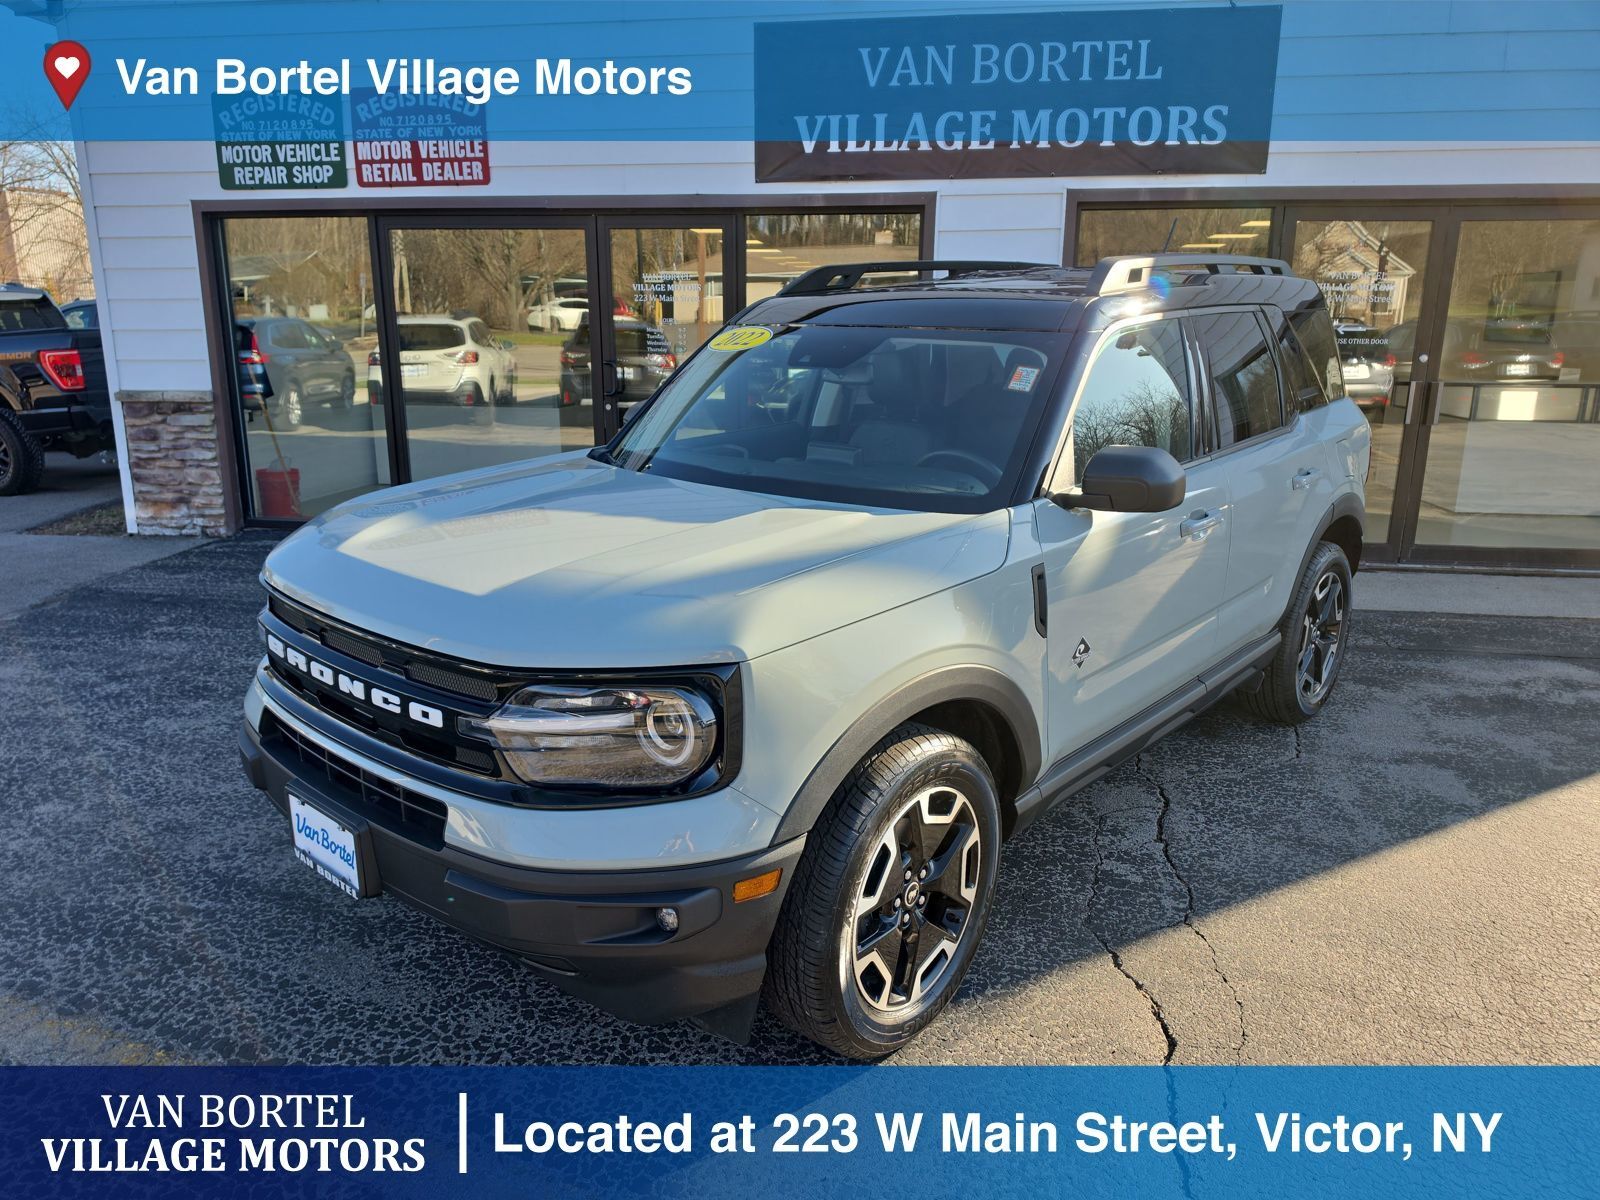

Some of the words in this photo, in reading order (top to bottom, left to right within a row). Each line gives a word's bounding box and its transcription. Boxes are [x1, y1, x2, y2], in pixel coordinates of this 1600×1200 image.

[858, 44, 957, 87] VAN
[971, 39, 1163, 84] BORTEL
[219, 93, 335, 130] REGISTERED
[221, 132, 255, 141] STATE
[259, 131, 273, 141] OF
[277, 130, 302, 140] NEW
[305, 129, 338, 140] YORK
[355, 128, 393, 139] STATE
[397, 127, 414, 138] OF
[421, 126, 444, 137] NEW
[447, 125, 483, 137] YORK
[793, 110, 998, 154] VILLAGE
[1009, 105, 1230, 149] MOTORS
[221, 145, 272, 164] MOTOR
[276, 142, 341, 163] VEHICLE
[357, 141, 412, 160] MOTOR
[417, 140, 484, 159] VEHICLE
[233, 165, 288, 185] REPAIR
[292, 164, 334, 184] SHOP
[361, 163, 417, 183] RETAIL
[421, 161, 484, 181] DEALER
[632, 283, 666, 291] VILLAGE
[634, 294, 648, 302] 223
[715, 331, 766, 346] 2022
[267, 634, 443, 728] BRONCO
[294, 847, 314, 869] VAN
[316, 864, 359, 900] BORTEL
